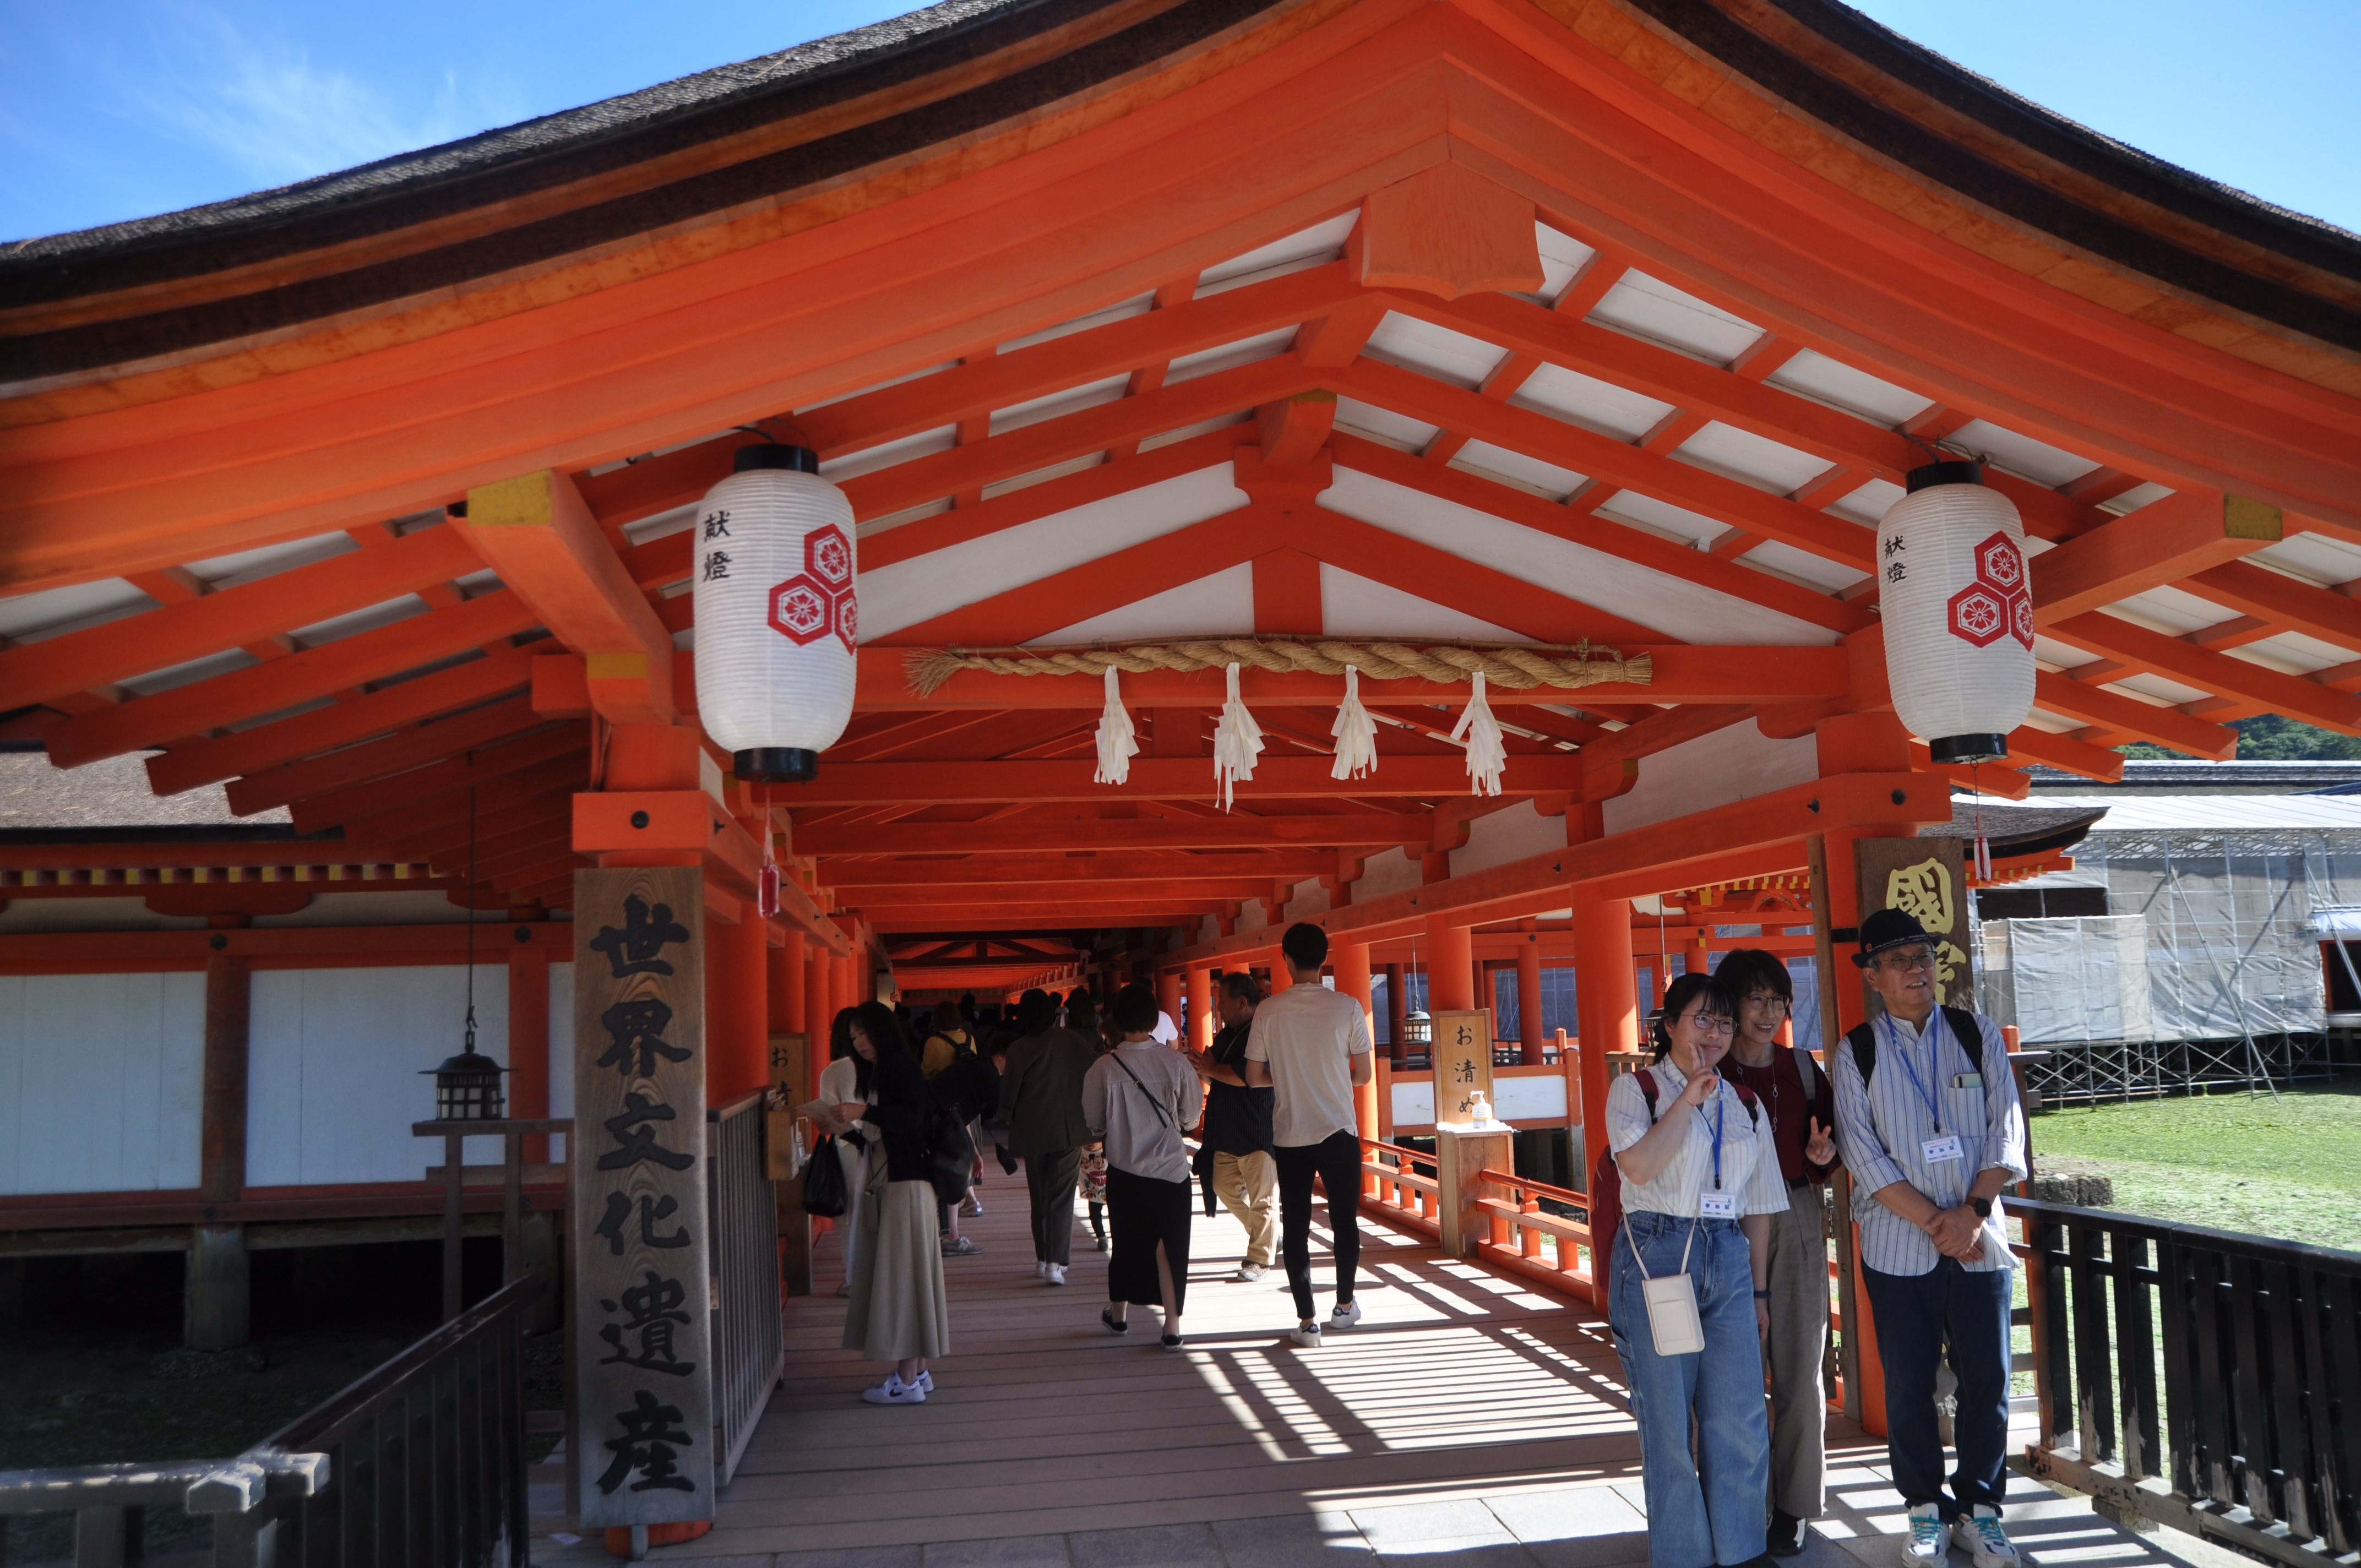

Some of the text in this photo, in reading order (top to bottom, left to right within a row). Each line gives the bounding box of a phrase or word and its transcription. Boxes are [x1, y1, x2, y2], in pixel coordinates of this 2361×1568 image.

[704, 510, 732, 582] 献燈
[1885, 535, 1907, 584] 献燈
[1454, 1025, 1477, 1113] お清め
[591, 893, 695, 1494] 世界文化遺産
